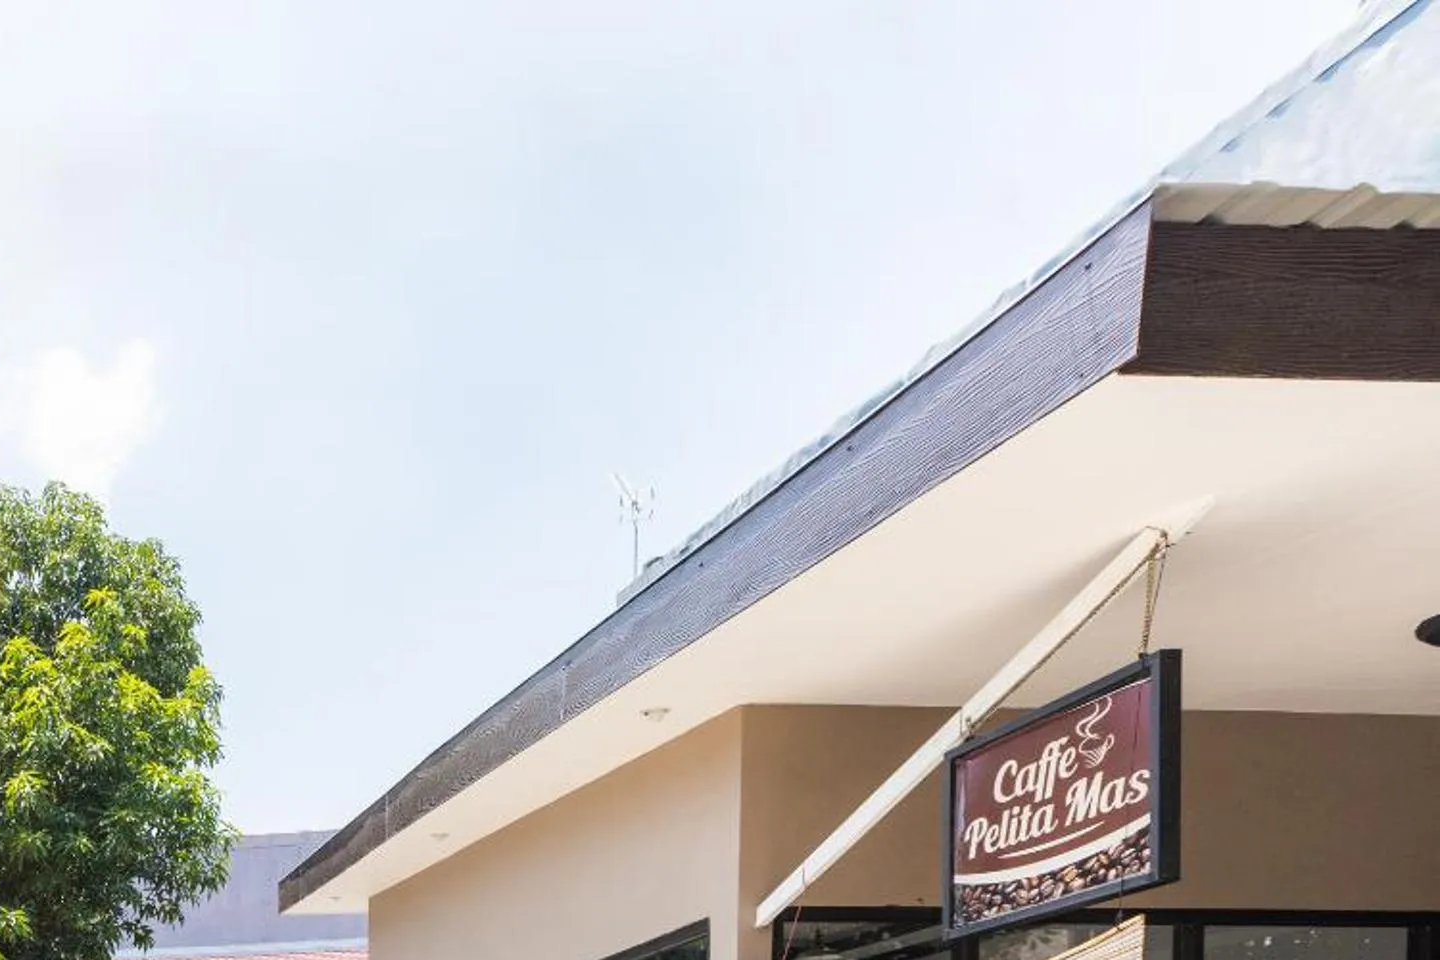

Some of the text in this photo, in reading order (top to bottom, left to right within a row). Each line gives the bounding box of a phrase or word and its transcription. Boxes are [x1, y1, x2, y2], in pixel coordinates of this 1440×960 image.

[994, 735, 1080, 803] Caffe
[964, 769, 1152, 860] Pelita Mas
